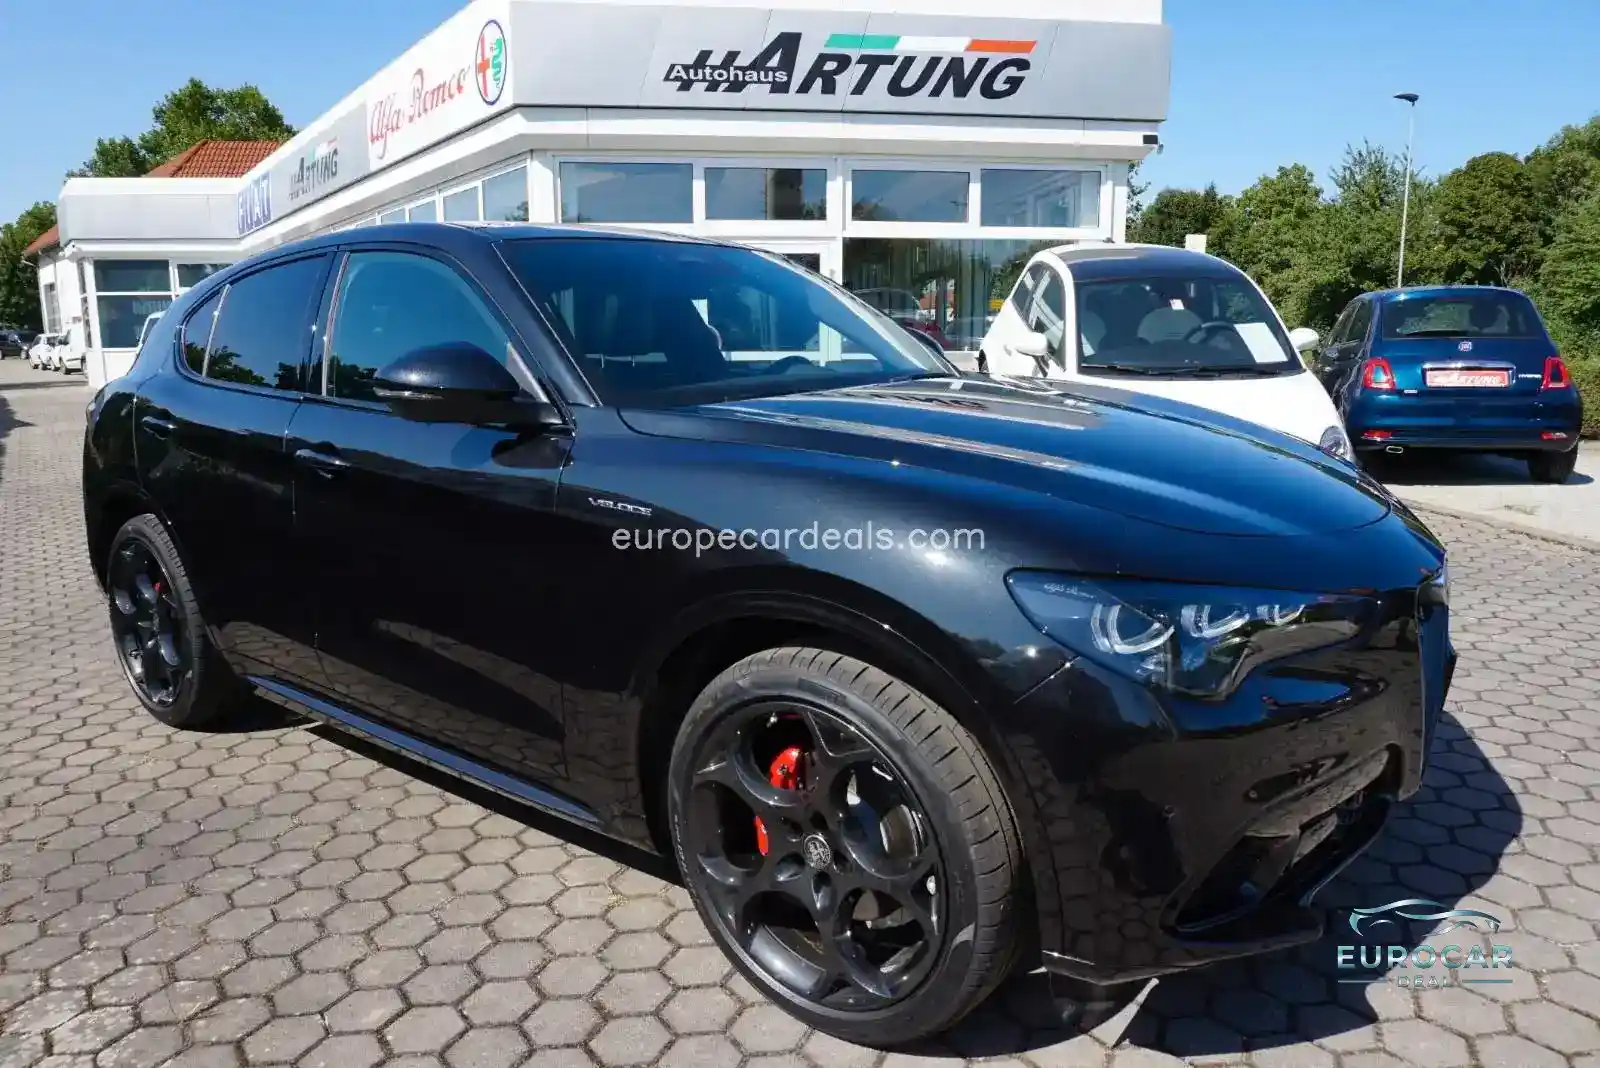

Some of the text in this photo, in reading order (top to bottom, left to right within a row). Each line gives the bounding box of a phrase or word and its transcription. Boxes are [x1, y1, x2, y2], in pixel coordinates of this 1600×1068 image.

[668, 63, 788, 83] Autohaus
[369, 66, 470, 160] Alfa Romeo
[588, 497, 652, 516] VELOCE
